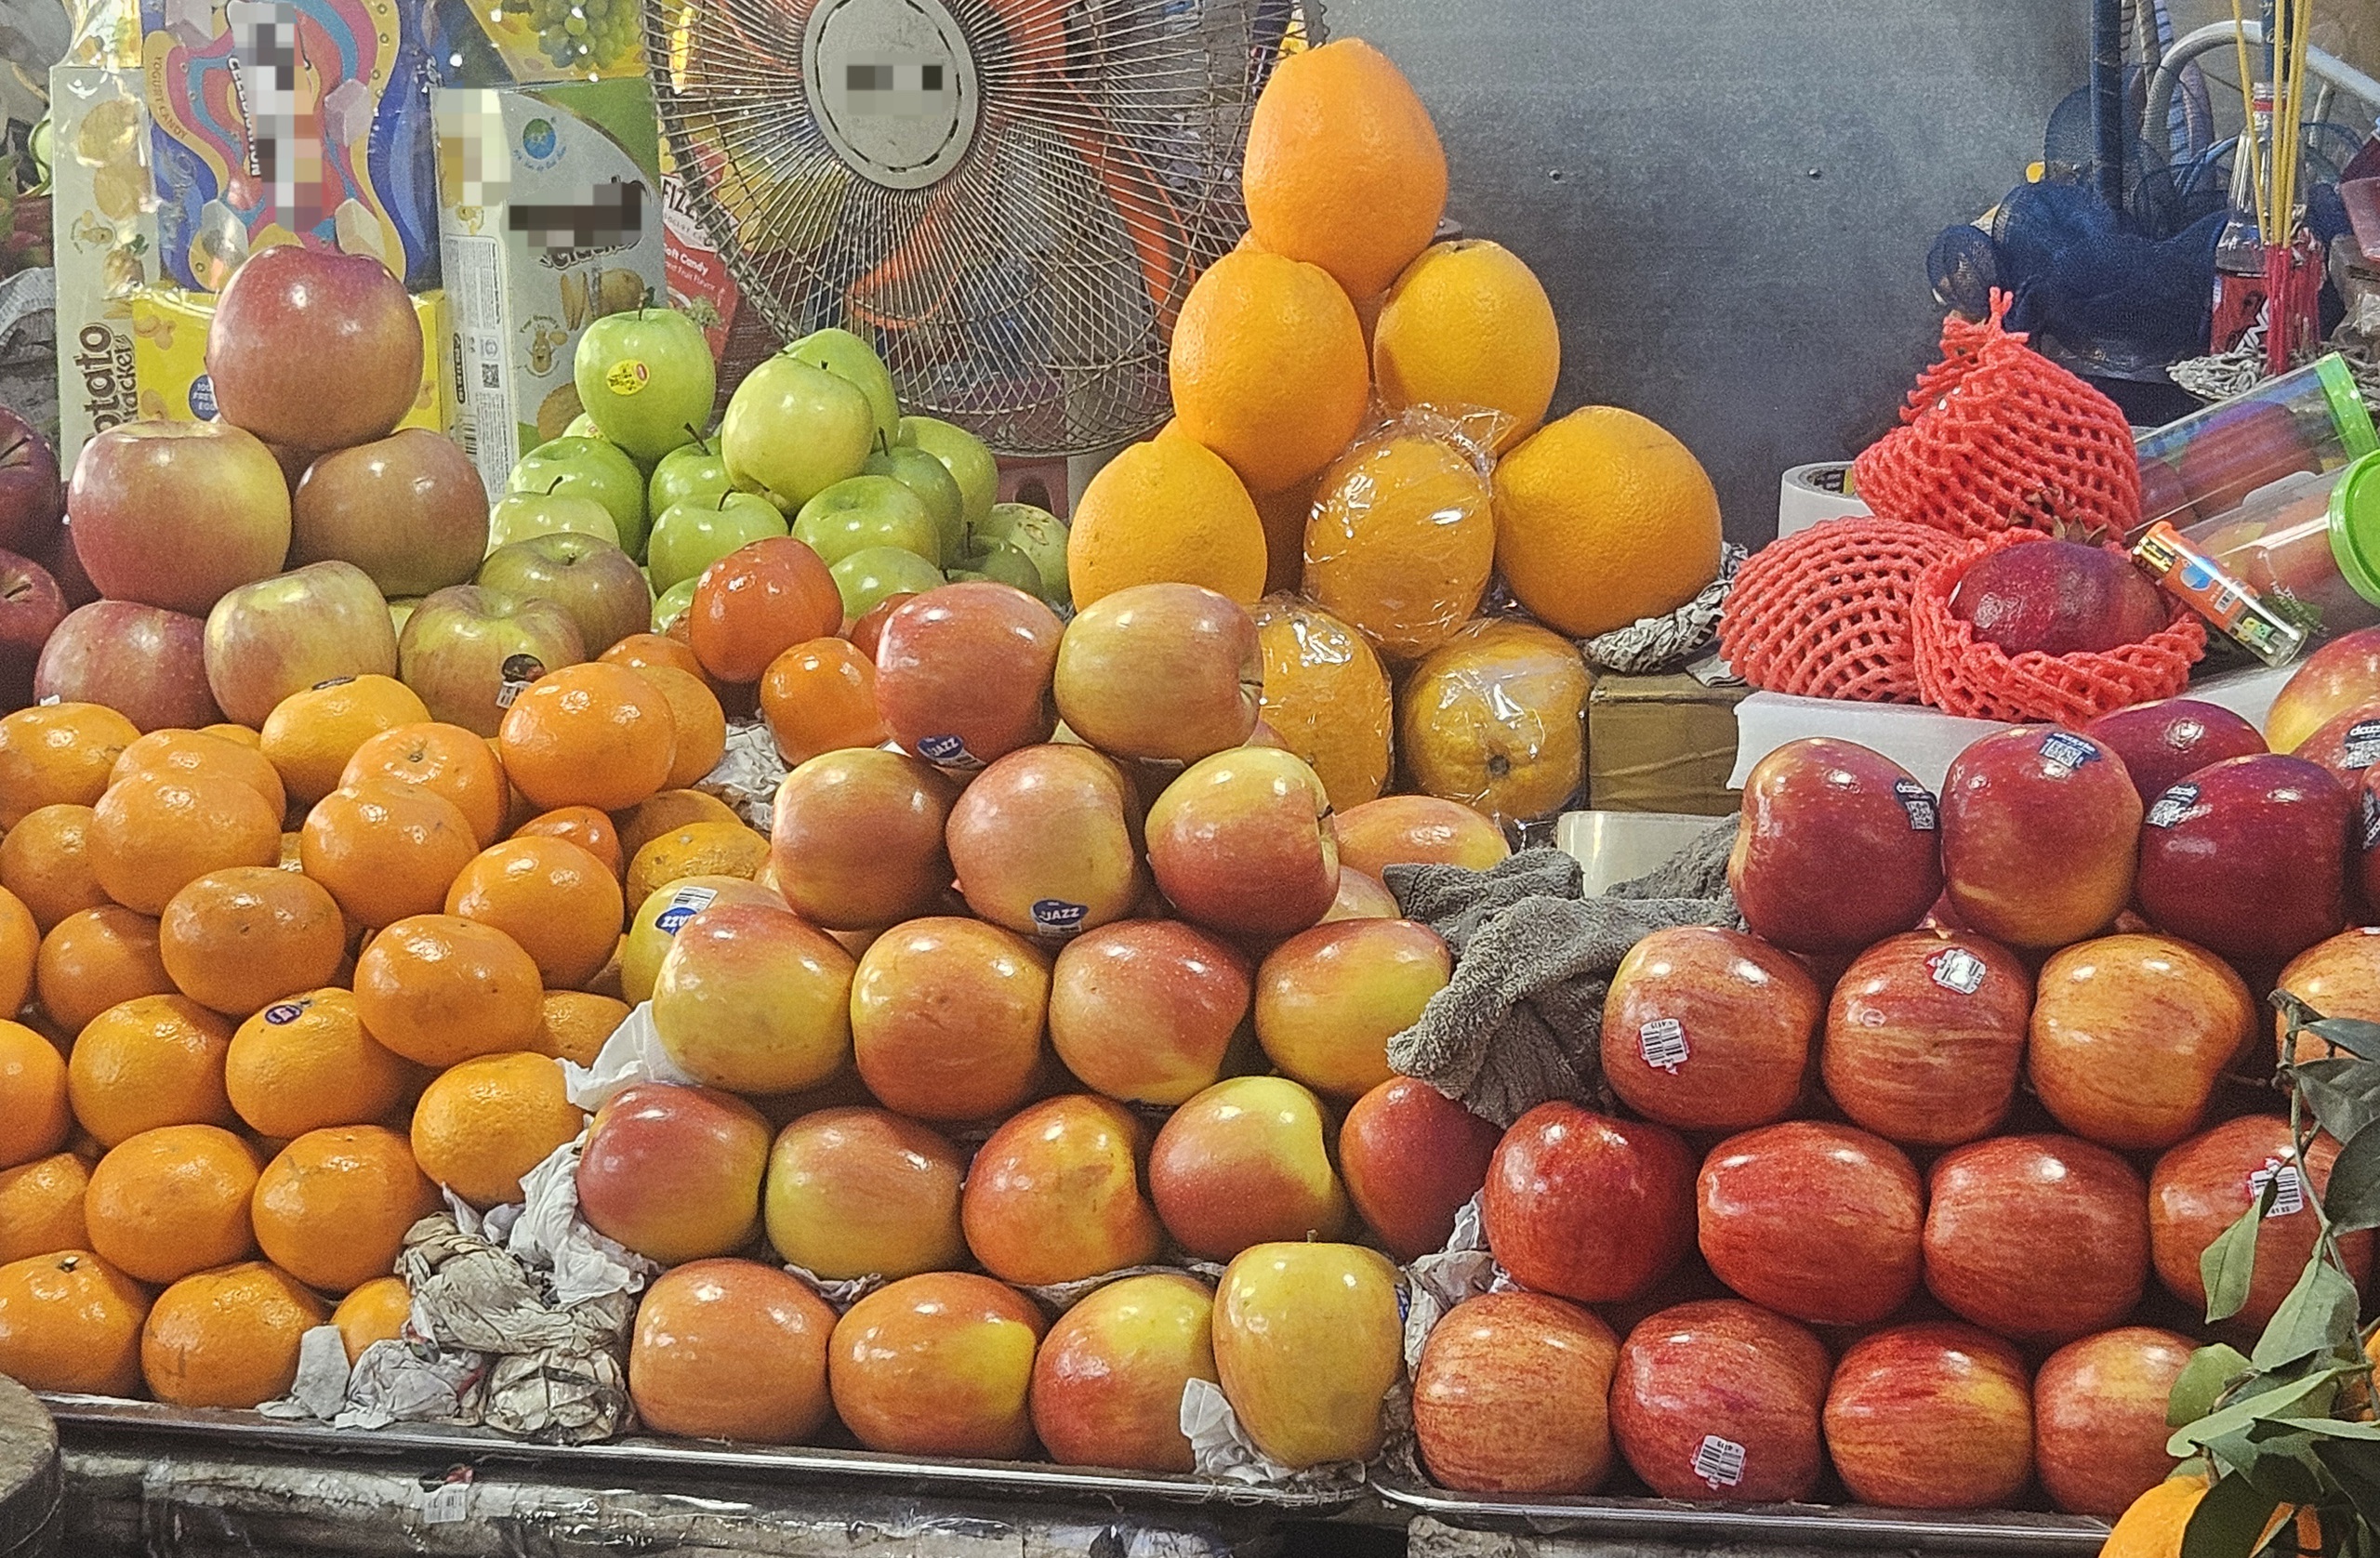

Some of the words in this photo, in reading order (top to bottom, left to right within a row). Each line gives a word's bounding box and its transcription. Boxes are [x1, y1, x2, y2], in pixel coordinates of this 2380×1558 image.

[158, 104, 188, 139] CANDY
[680, 253, 708, 277] Candy
[73, 323, 122, 440] otato
[931, 737, 959, 757] JAZZ
[660, 915, 690, 928] AZZ
[1038, 907, 1080, 921] JAZZ
